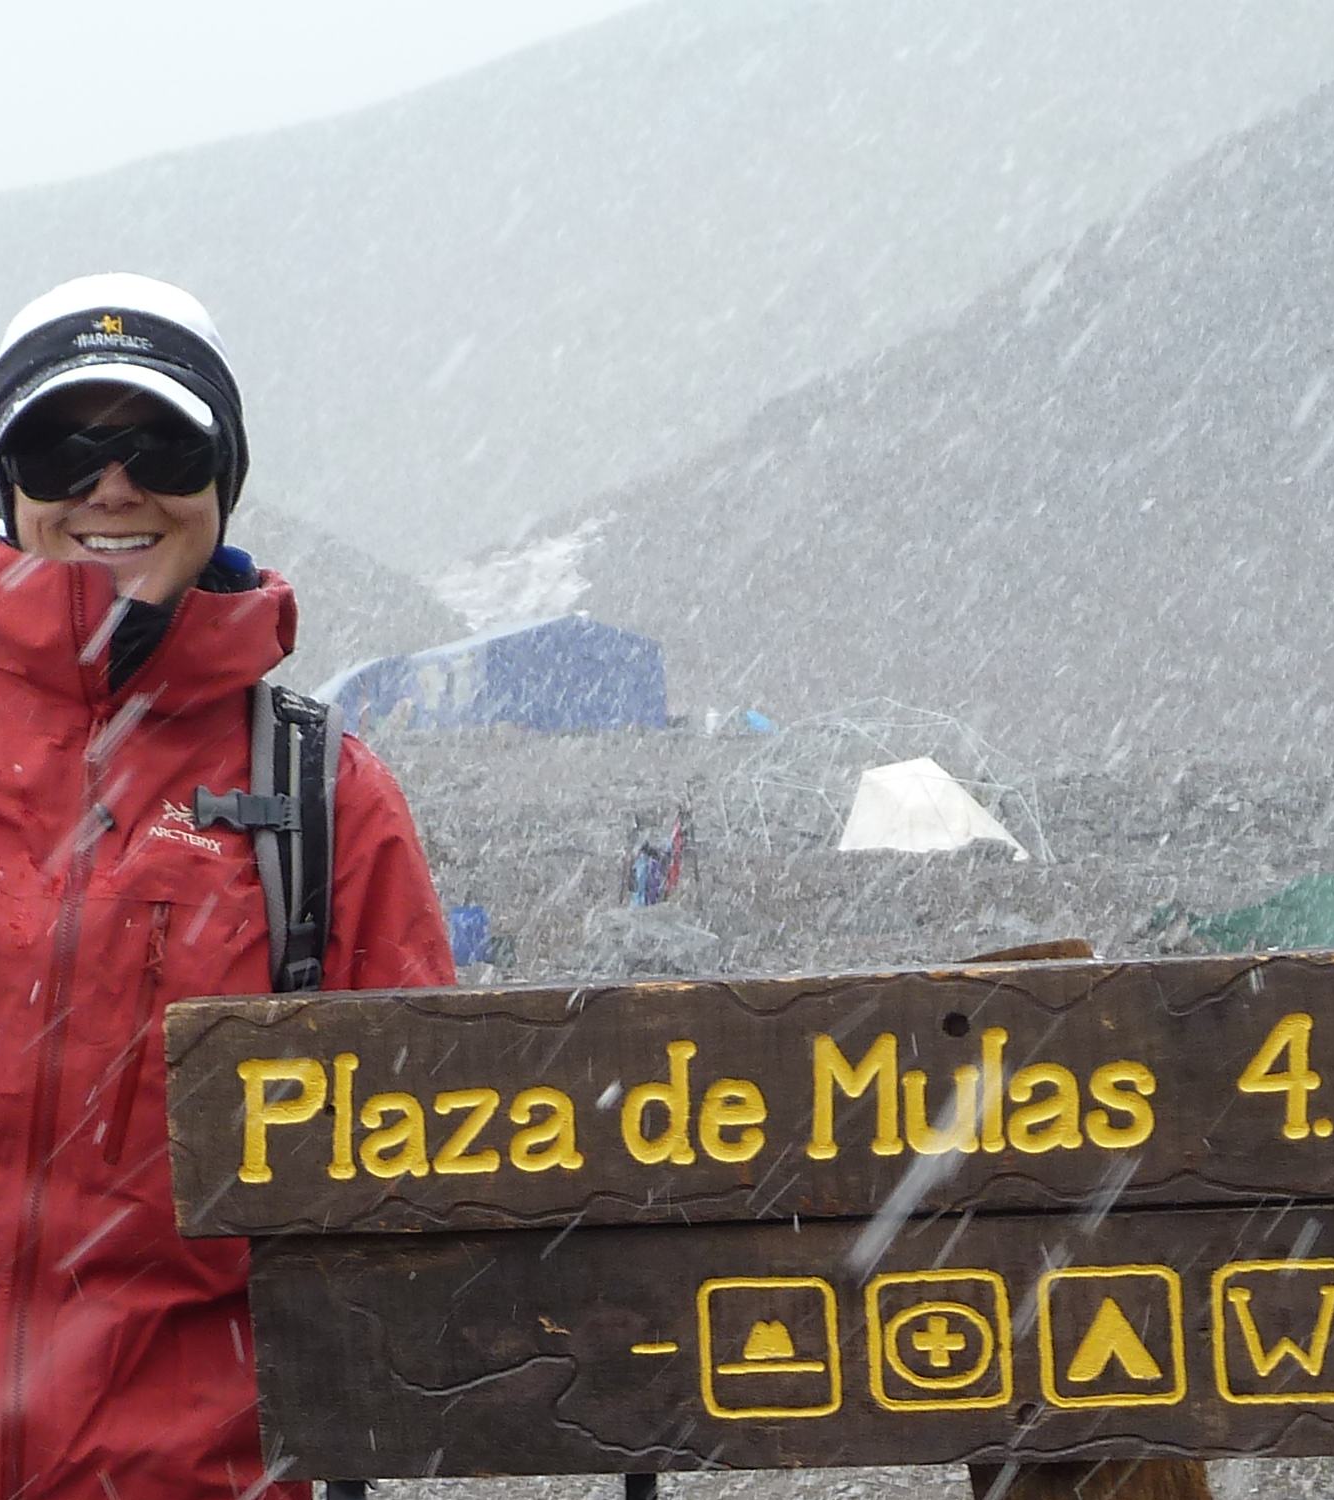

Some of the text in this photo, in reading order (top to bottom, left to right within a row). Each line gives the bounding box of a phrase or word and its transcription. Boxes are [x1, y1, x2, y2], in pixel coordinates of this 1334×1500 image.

[237, 1052, 584, 1184] Plaza
[620, 1039, 768, 1166] de
[807, 1026, 1156, 1160] Mulas
